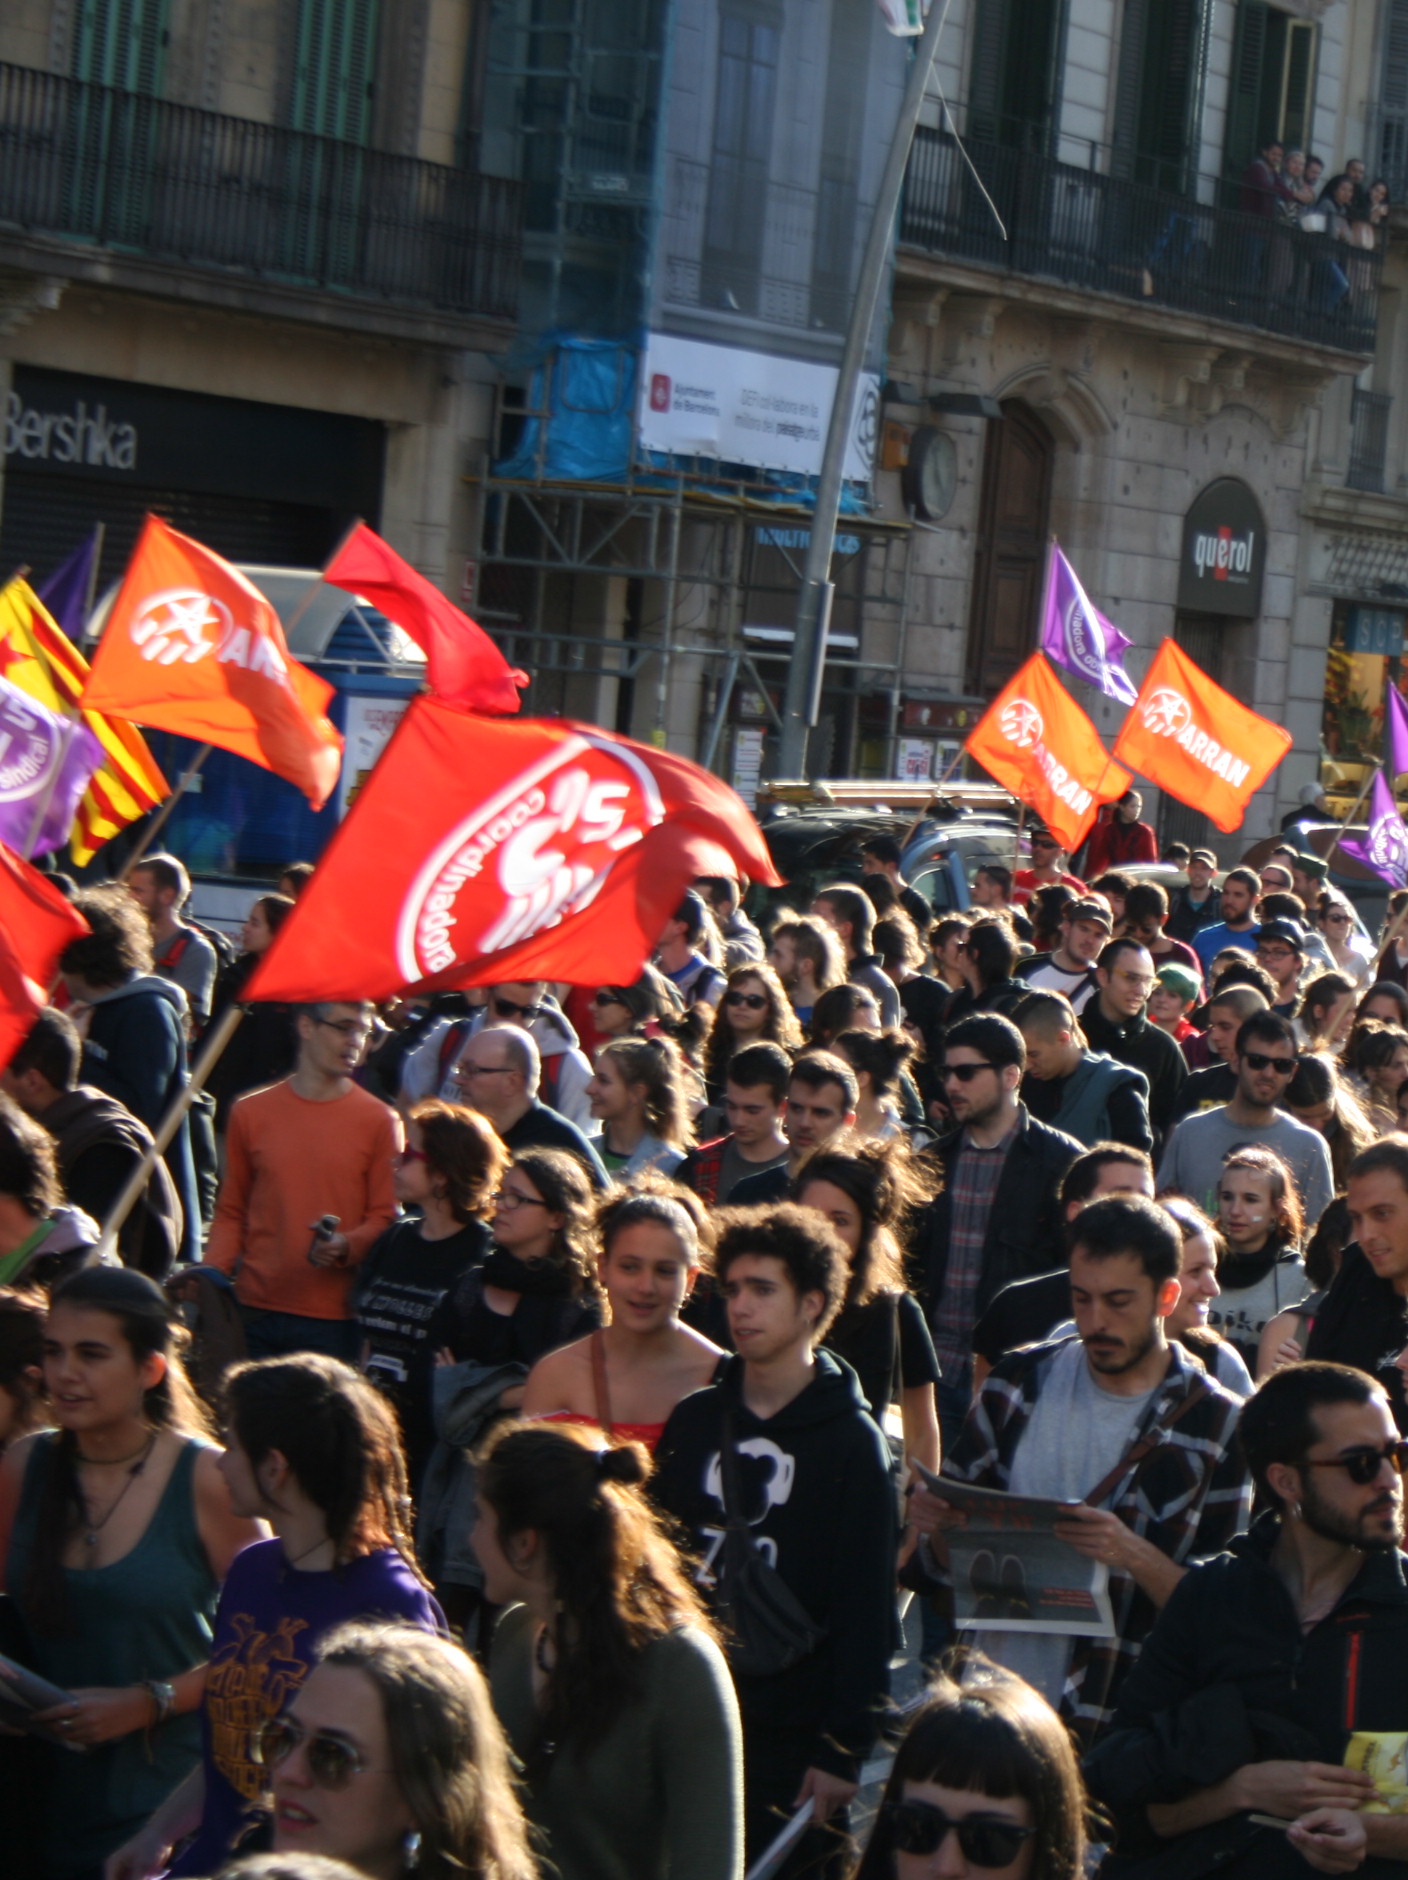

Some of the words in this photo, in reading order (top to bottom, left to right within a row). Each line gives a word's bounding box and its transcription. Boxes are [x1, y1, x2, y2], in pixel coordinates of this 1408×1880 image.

[3, 391, 137, 470] Bershka
[1194, 530, 1255, 578] querol
[1032, 743, 1093, 816] ARRAN
[1177, 724, 1250, 788] ARRAN
[419, 788, 546, 974] coordinadora
